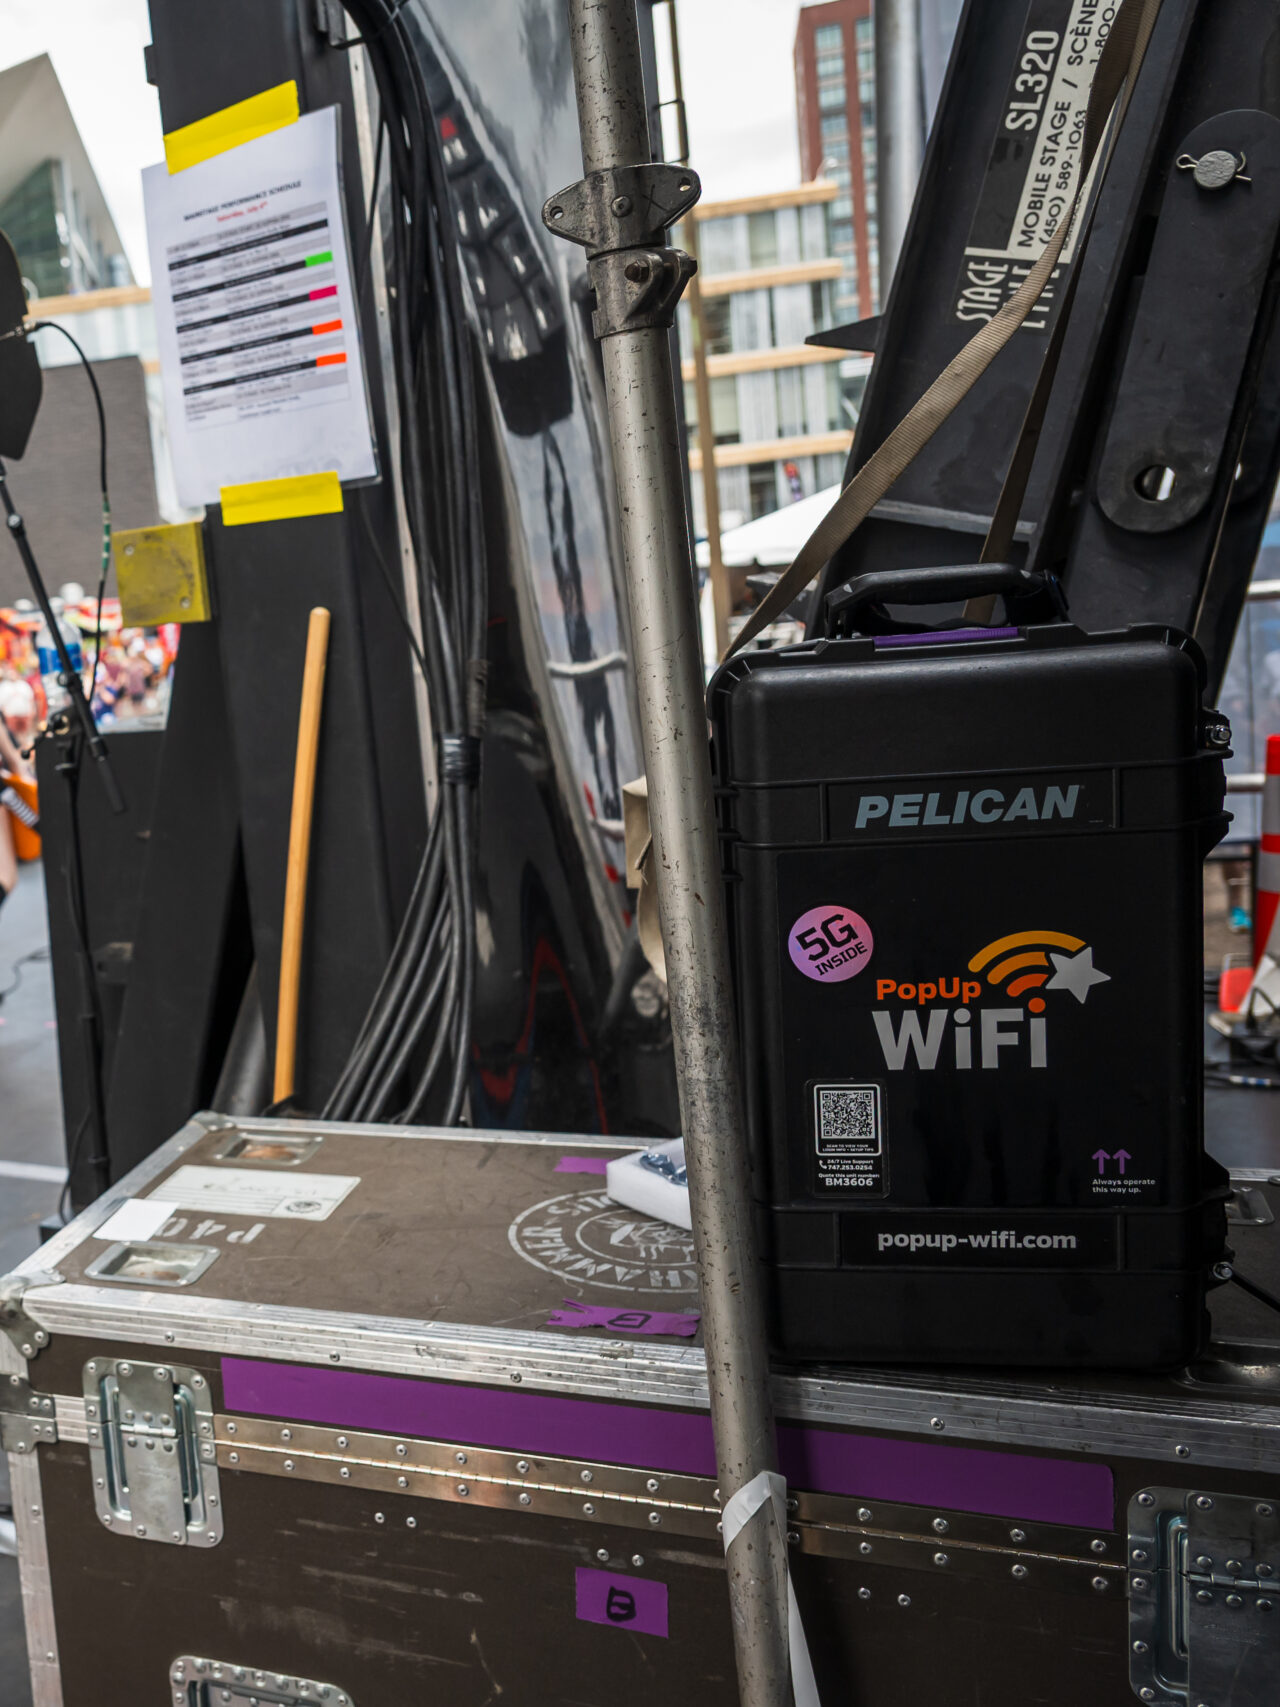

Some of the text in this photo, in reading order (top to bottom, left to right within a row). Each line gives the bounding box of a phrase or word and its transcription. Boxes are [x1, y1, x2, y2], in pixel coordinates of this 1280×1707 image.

[1005, 30, 1060, 131] SL320
[1018, 173, 1051, 247] MOBILE
[1040, 101, 1071, 167] STAGE
[1067, 0, 1099, 66] SCÈNE
[1039, 196, 1066, 244] (450)
[1056, 110, 1087, 190] 589-1063
[956, 261, 1009, 323] STAGE
[855, 785, 1080, 829] PELICAN
[796, 914, 859, 962] 5G
[815, 941, 868, 976] INSIDE
[876, 977, 982, 1005] PopUp
[872, 998, 1047, 1071] WiFi
[825, 1178, 873, 1186] BM3606
[877, 1230, 1077, 1252] popup-wifi.com
